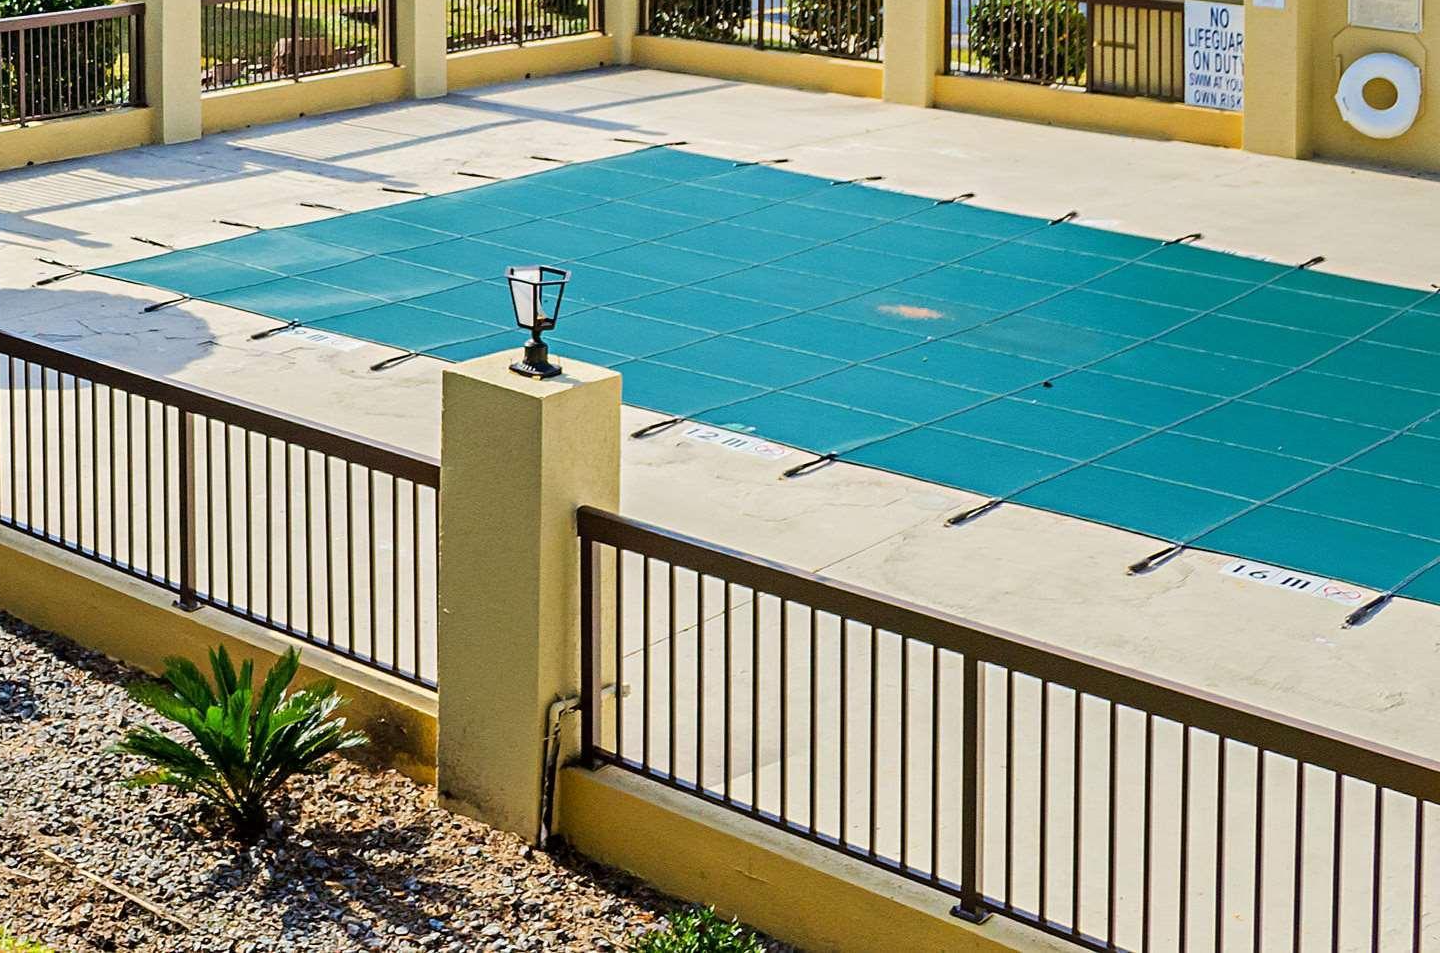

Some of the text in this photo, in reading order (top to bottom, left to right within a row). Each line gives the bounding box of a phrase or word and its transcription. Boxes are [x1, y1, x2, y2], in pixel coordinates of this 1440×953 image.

[1210, 7, 1229, 28] NO
[1188, 27, 1244, 52] LIFEGUAR
[1193, 50, 1210, 71] ON
[1189, 72, 1244, 92] SWIM AT YOU
[1194, 89, 1217, 105] OWN
